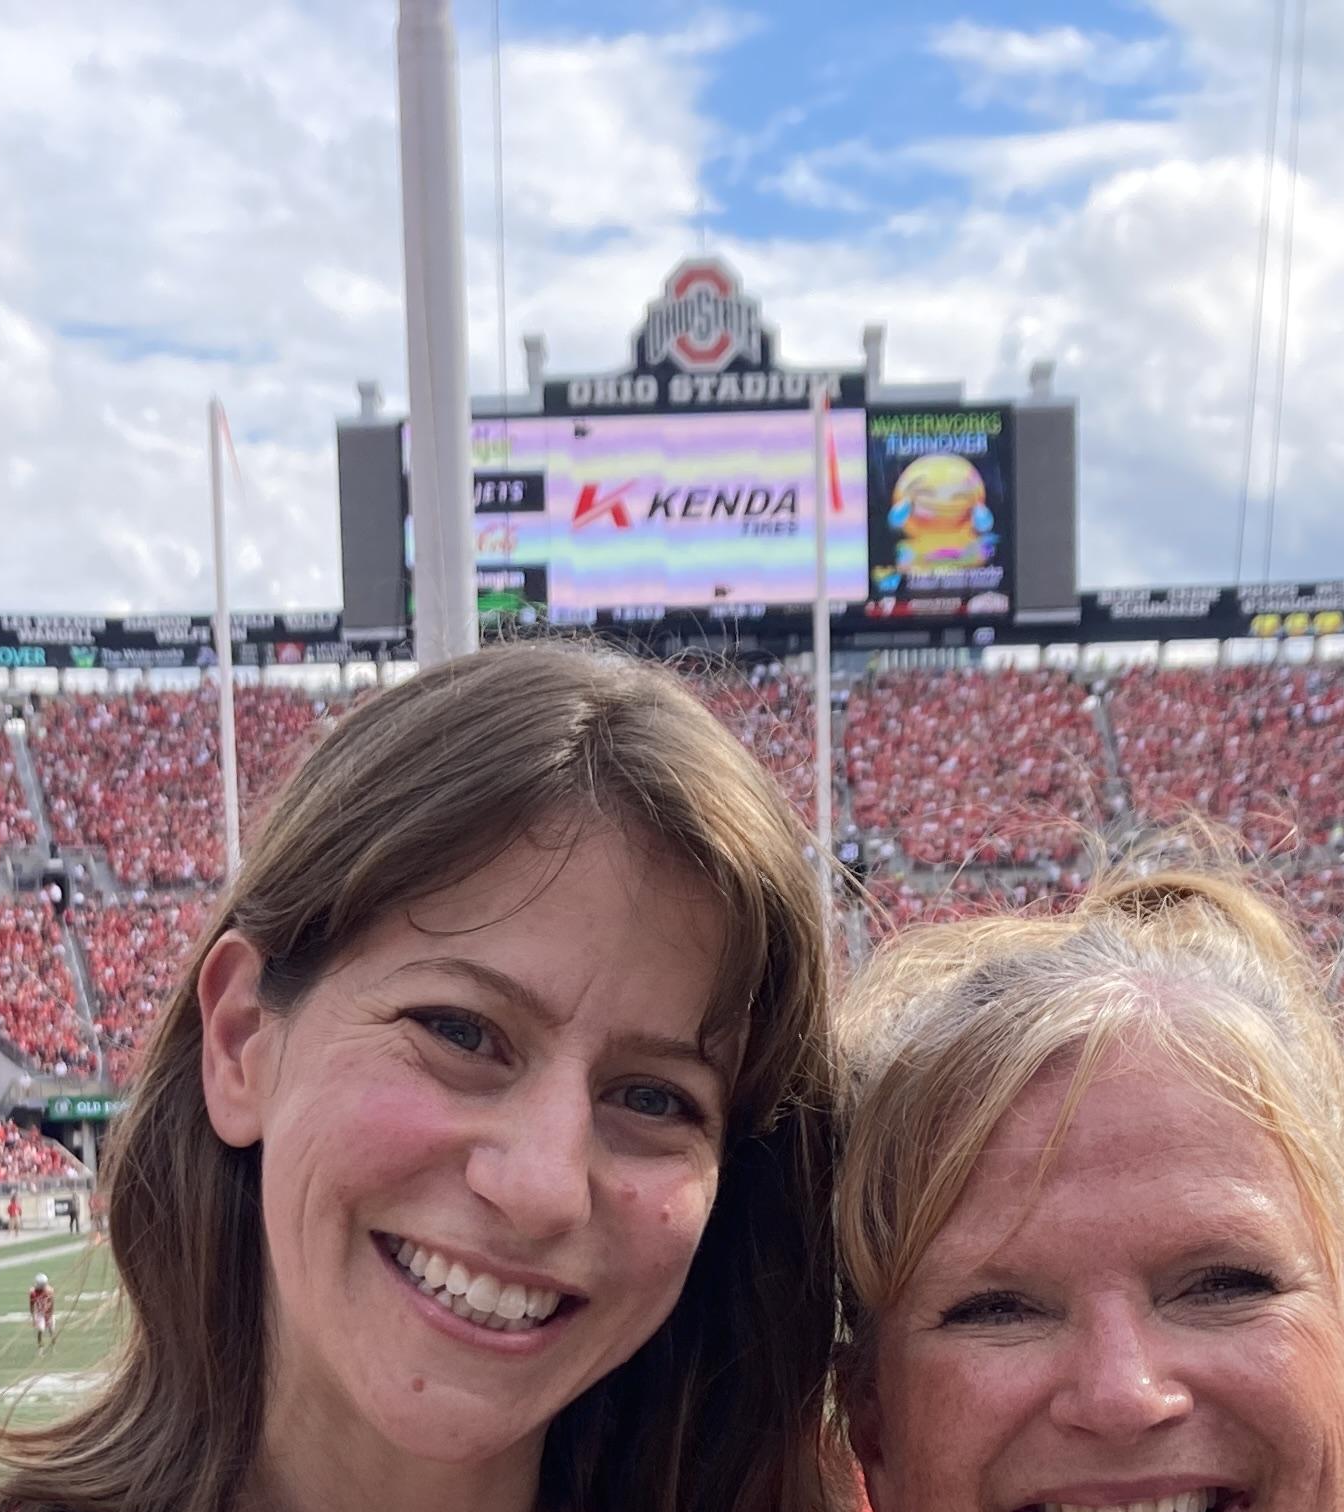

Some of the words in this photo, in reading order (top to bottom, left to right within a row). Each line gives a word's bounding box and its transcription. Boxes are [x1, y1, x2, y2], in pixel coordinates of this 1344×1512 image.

[567, 375, 659, 408] OHIO
[668, 370, 842, 404] STADIUM
[871, 412, 1002, 437] WATERWORKS
[885, 432, 988, 455] TURNOVER
[646, 483, 798, 519] KENDA
